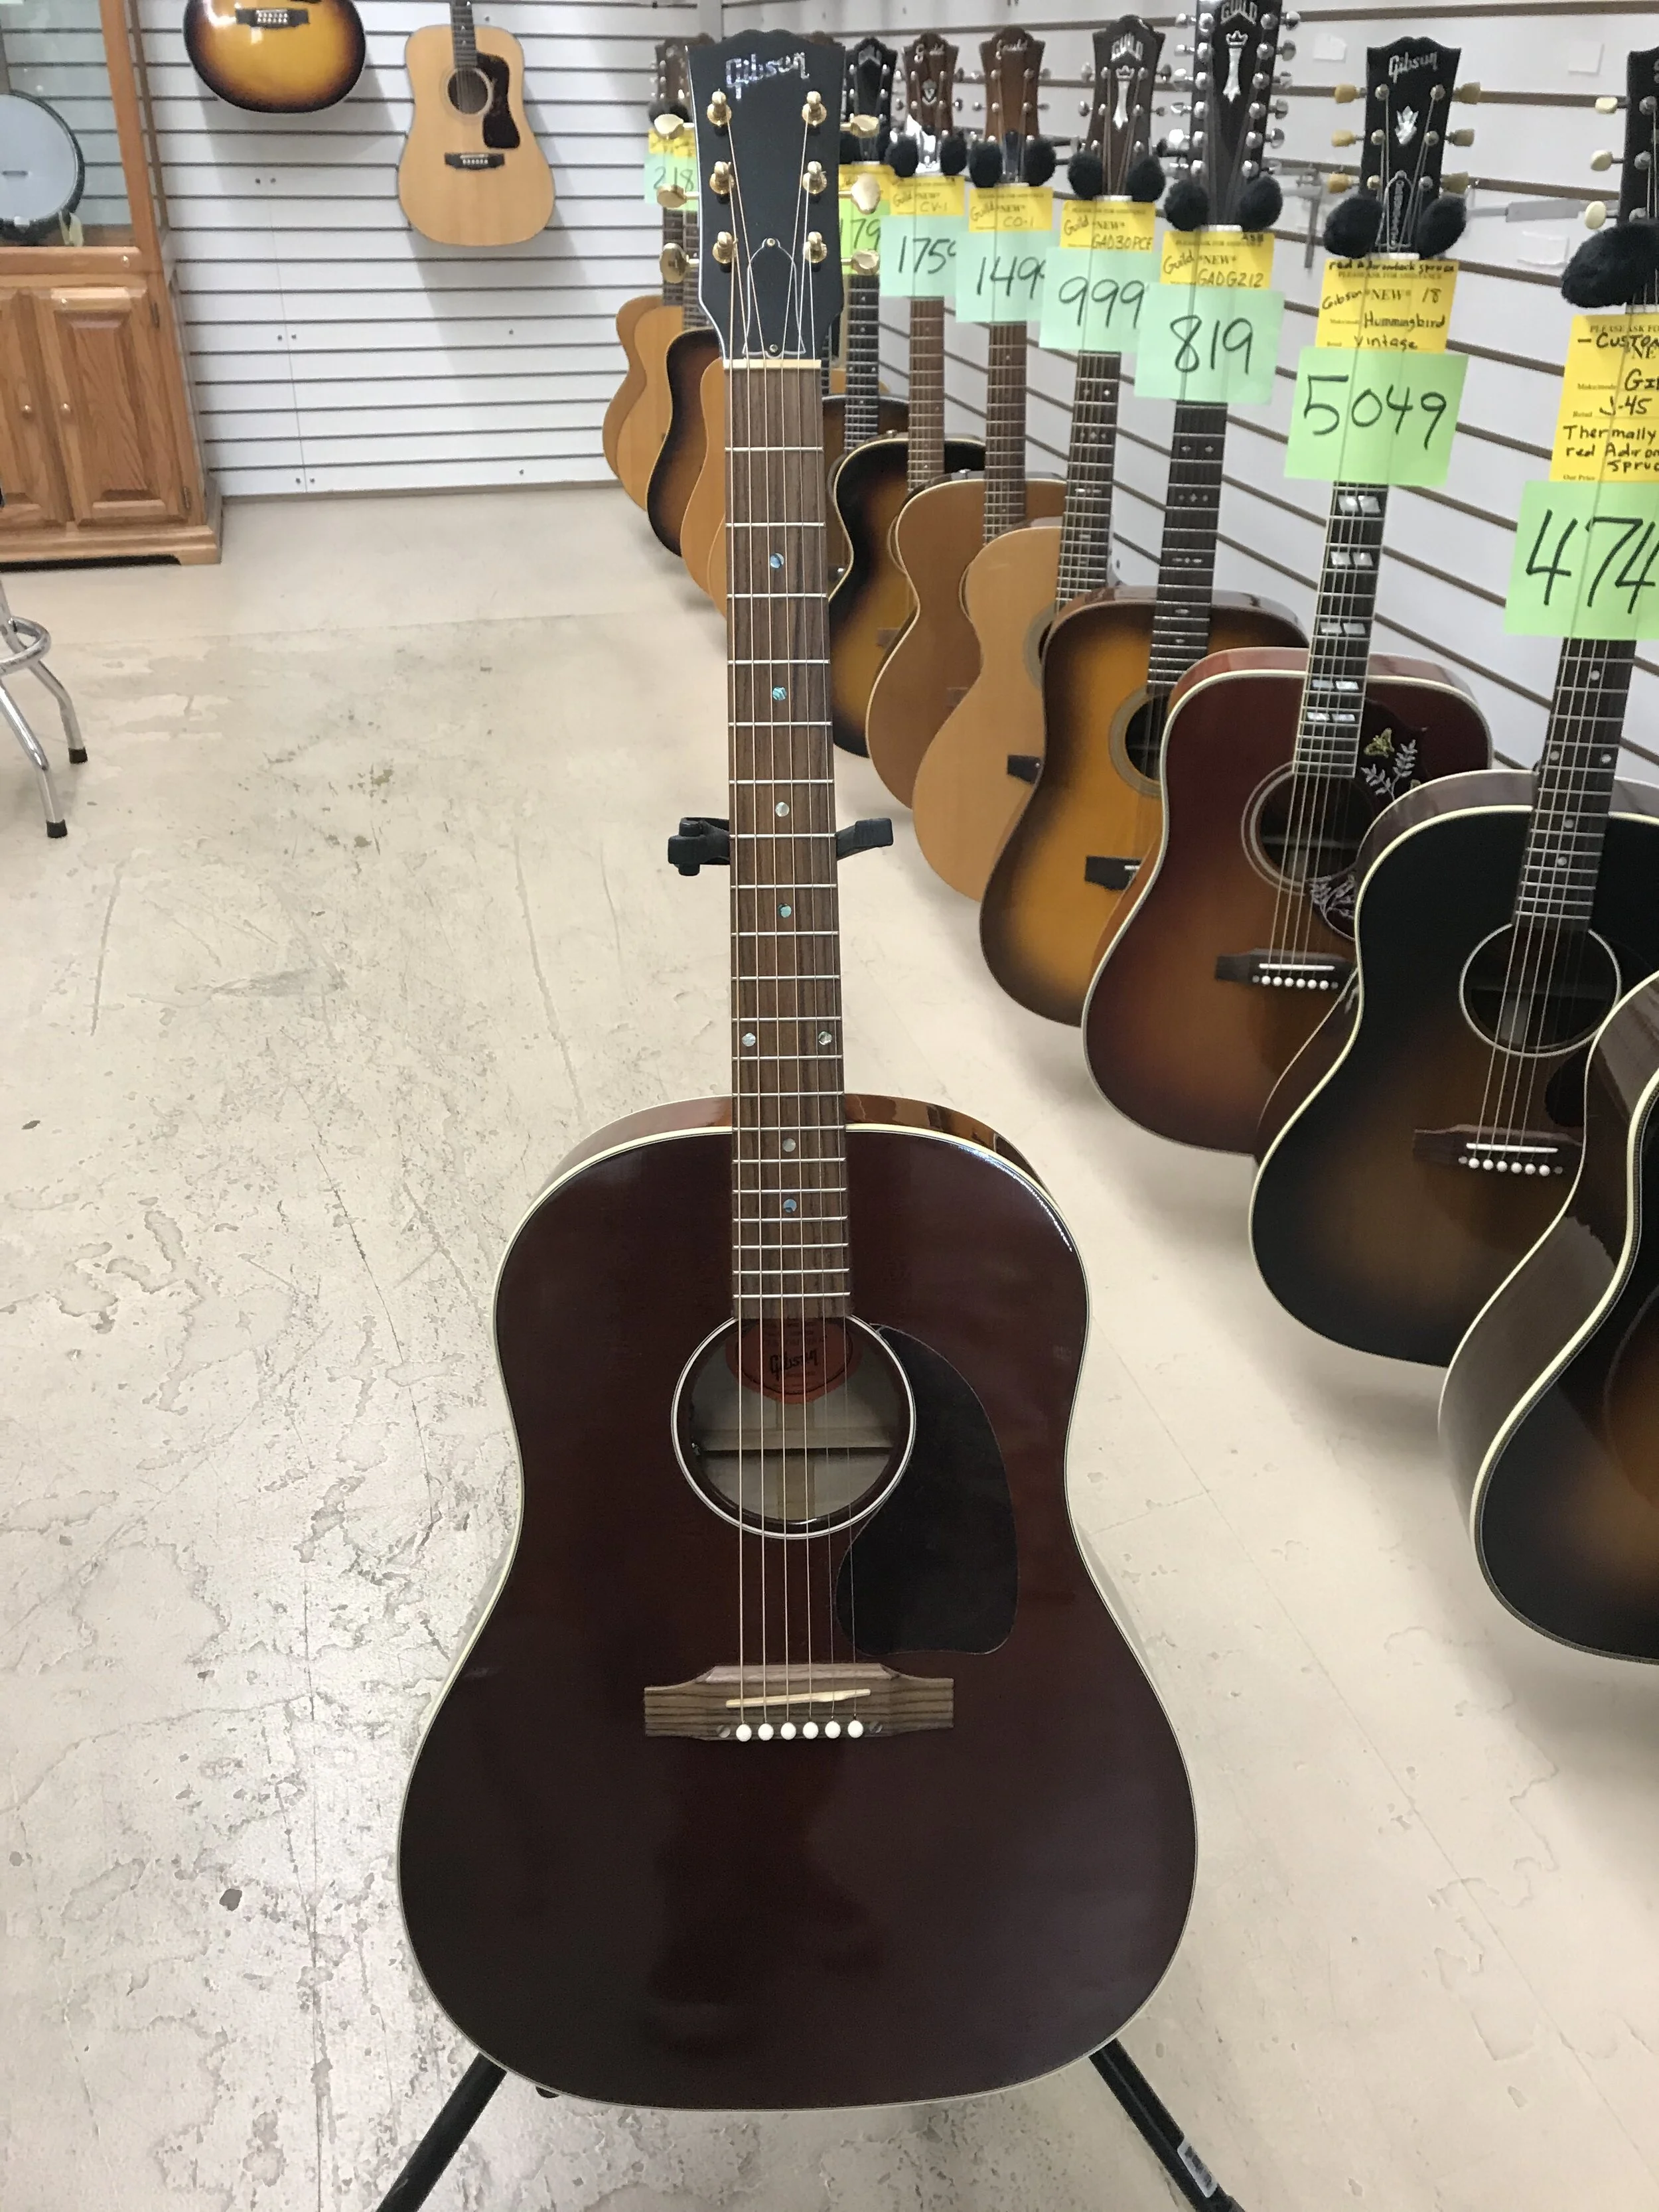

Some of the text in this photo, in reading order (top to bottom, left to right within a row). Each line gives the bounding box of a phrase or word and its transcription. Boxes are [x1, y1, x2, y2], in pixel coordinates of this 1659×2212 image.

[725, 52, 810, 101] Gibson
[1388, 52, 1438, 84] Gibson
[1163, 250, 1195, 274] Guild
[1197, 267, 1264, 288] GADG212
[1058, 275, 1145, 329] 999
[1322, 290, 1362, 310] Gibson
[1422, 288, 1442, 303] 18
[1364, 311, 1446, 332] Hummingbird
[1169, 314, 1254, 376] 819
[1303, 374, 1447, 451] 5049
[1599, 396, 1652, 416] J-45
[1563, 425, 1657, 446] Thermally
[1566, 443, 1595, 457] red
[1526, 508, 1659, 615] 474
[770, 1349, 818, 1381] Gibson
